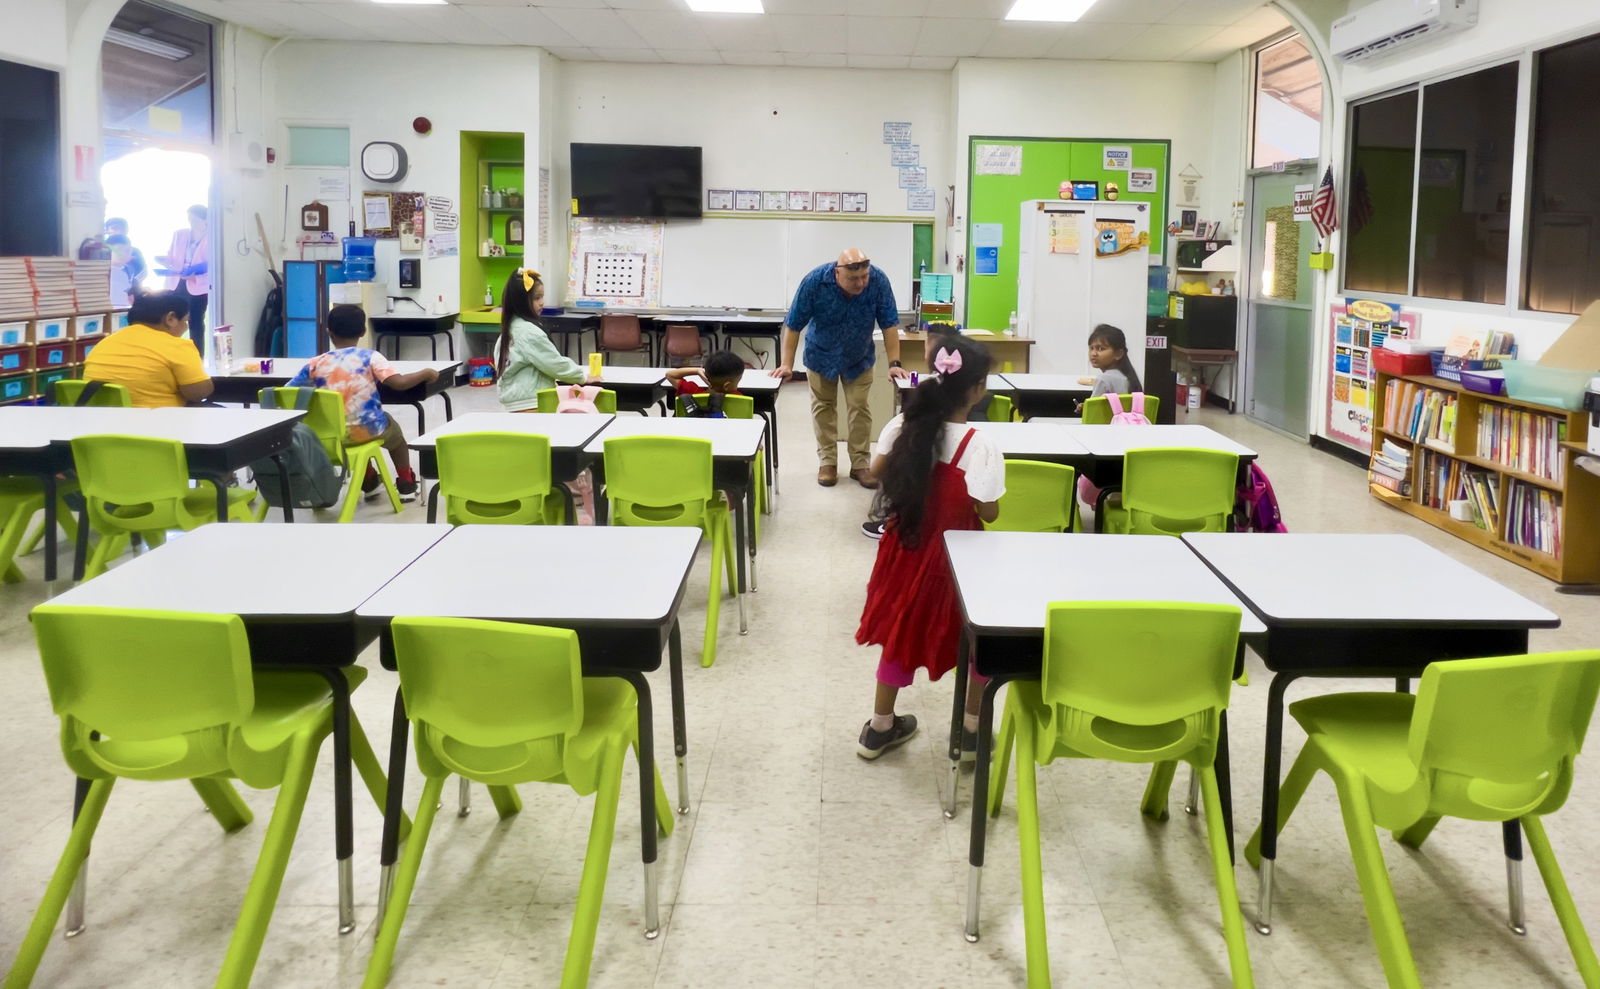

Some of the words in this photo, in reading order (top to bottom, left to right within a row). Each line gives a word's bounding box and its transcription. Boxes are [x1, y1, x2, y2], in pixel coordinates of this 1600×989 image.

[1273, 162, 1284, 171] EXIT
[1295, 192, 1313, 201] EXIT
[1294, 205, 1312, 213] ONLY
[1146, 337, 1165, 347] EXIT
